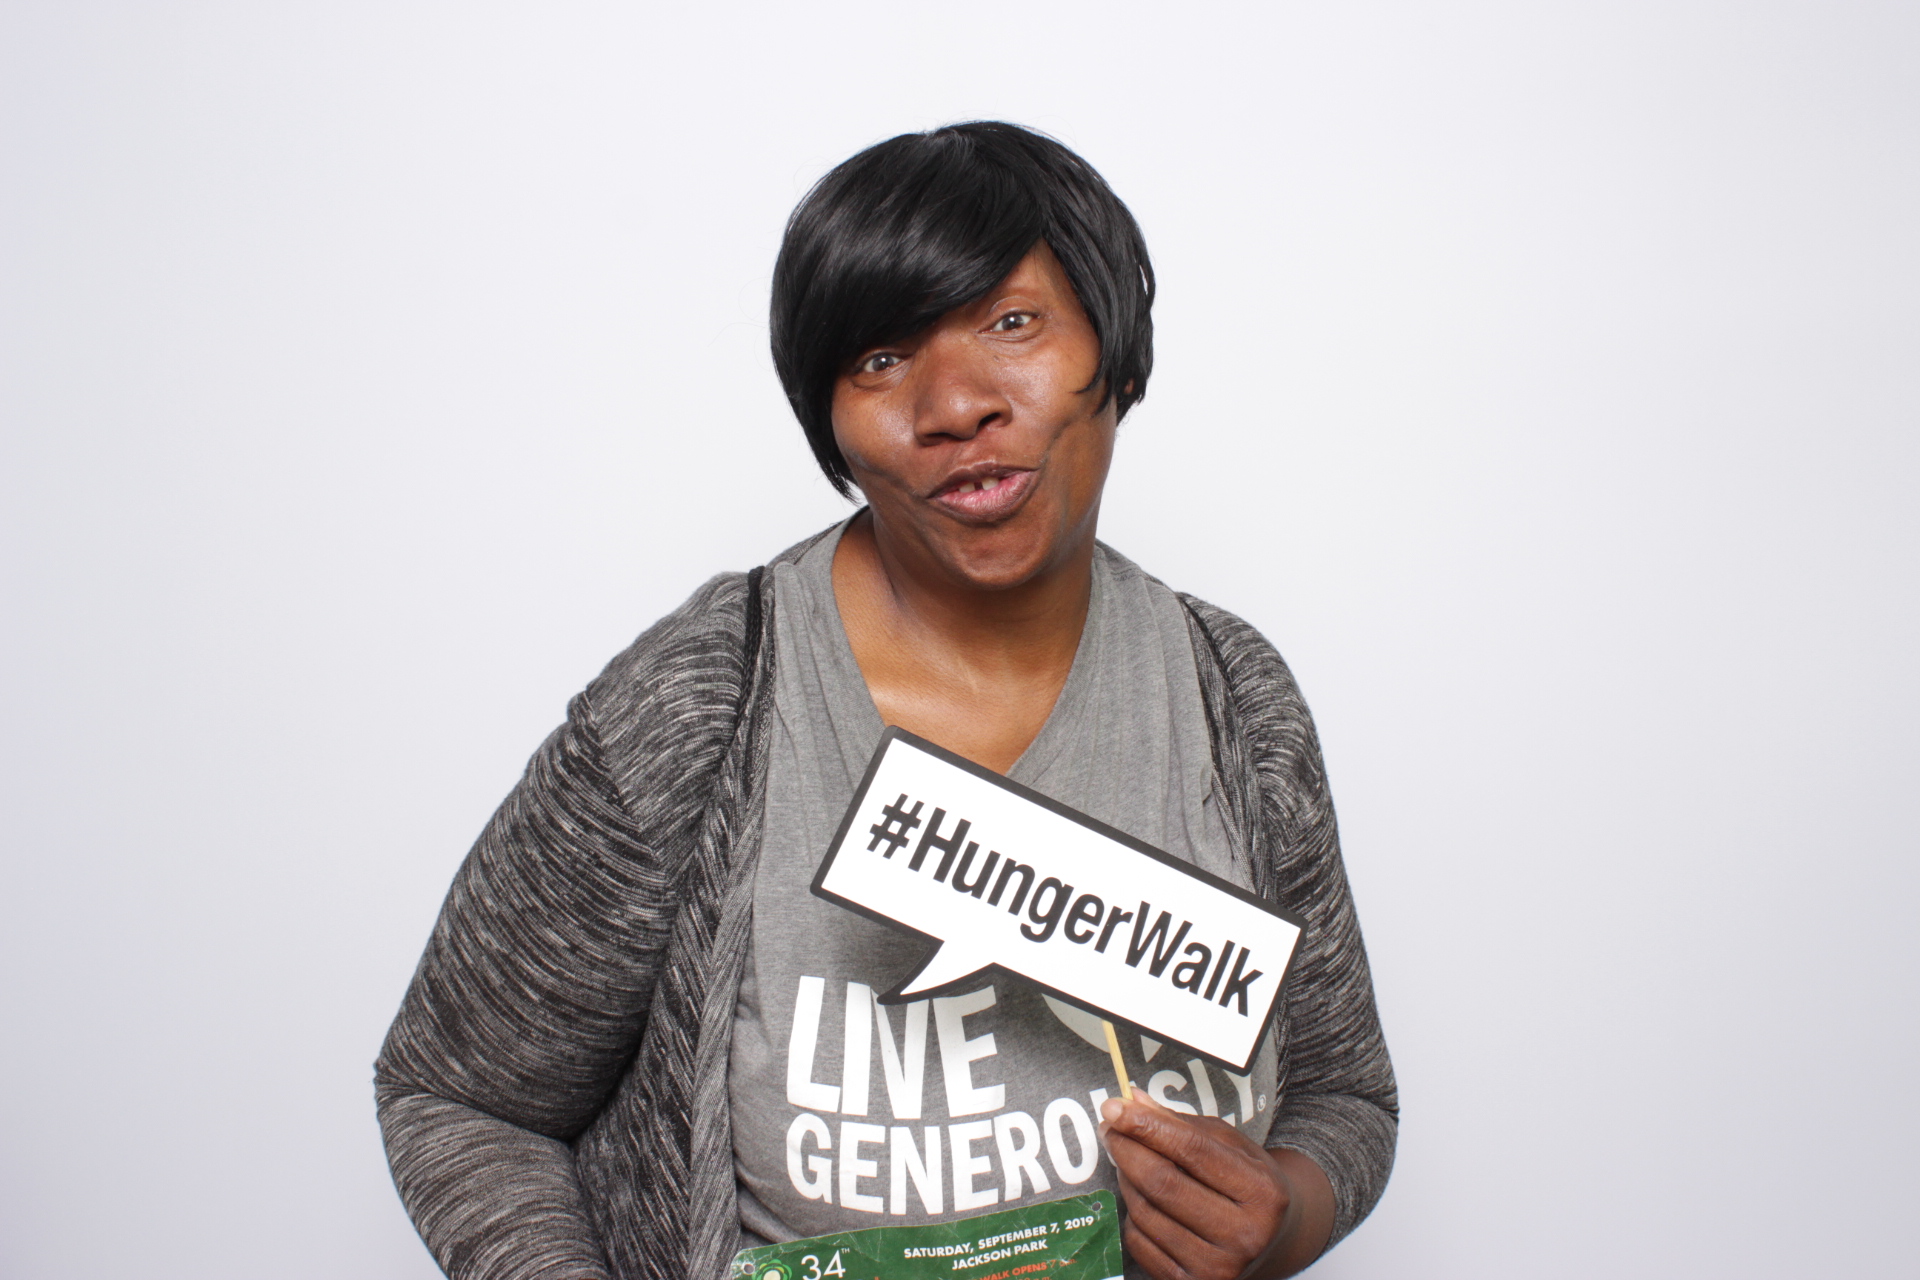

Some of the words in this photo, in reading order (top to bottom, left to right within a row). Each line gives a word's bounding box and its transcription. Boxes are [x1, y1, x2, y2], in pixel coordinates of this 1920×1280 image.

[866, 793, 1264, 1017] #HungerWalk
[787, 976, 1006, 1119] LIVE
[904, 1242, 974, 1259] SATURDAY,
[978, 1225, 1048, 1250] SEPTEMBER
[1050, 1223, 1061, 1234] 7,
[1064, 1215, 1095, 1231] 2019
[952, 1246, 1012, 1270] JACKSON
[1014, 1239, 1048, 1256] PARK
[1012, 1261, 1047, 1276] OPENS
[1050, 1259, 1056, 1268] 7
